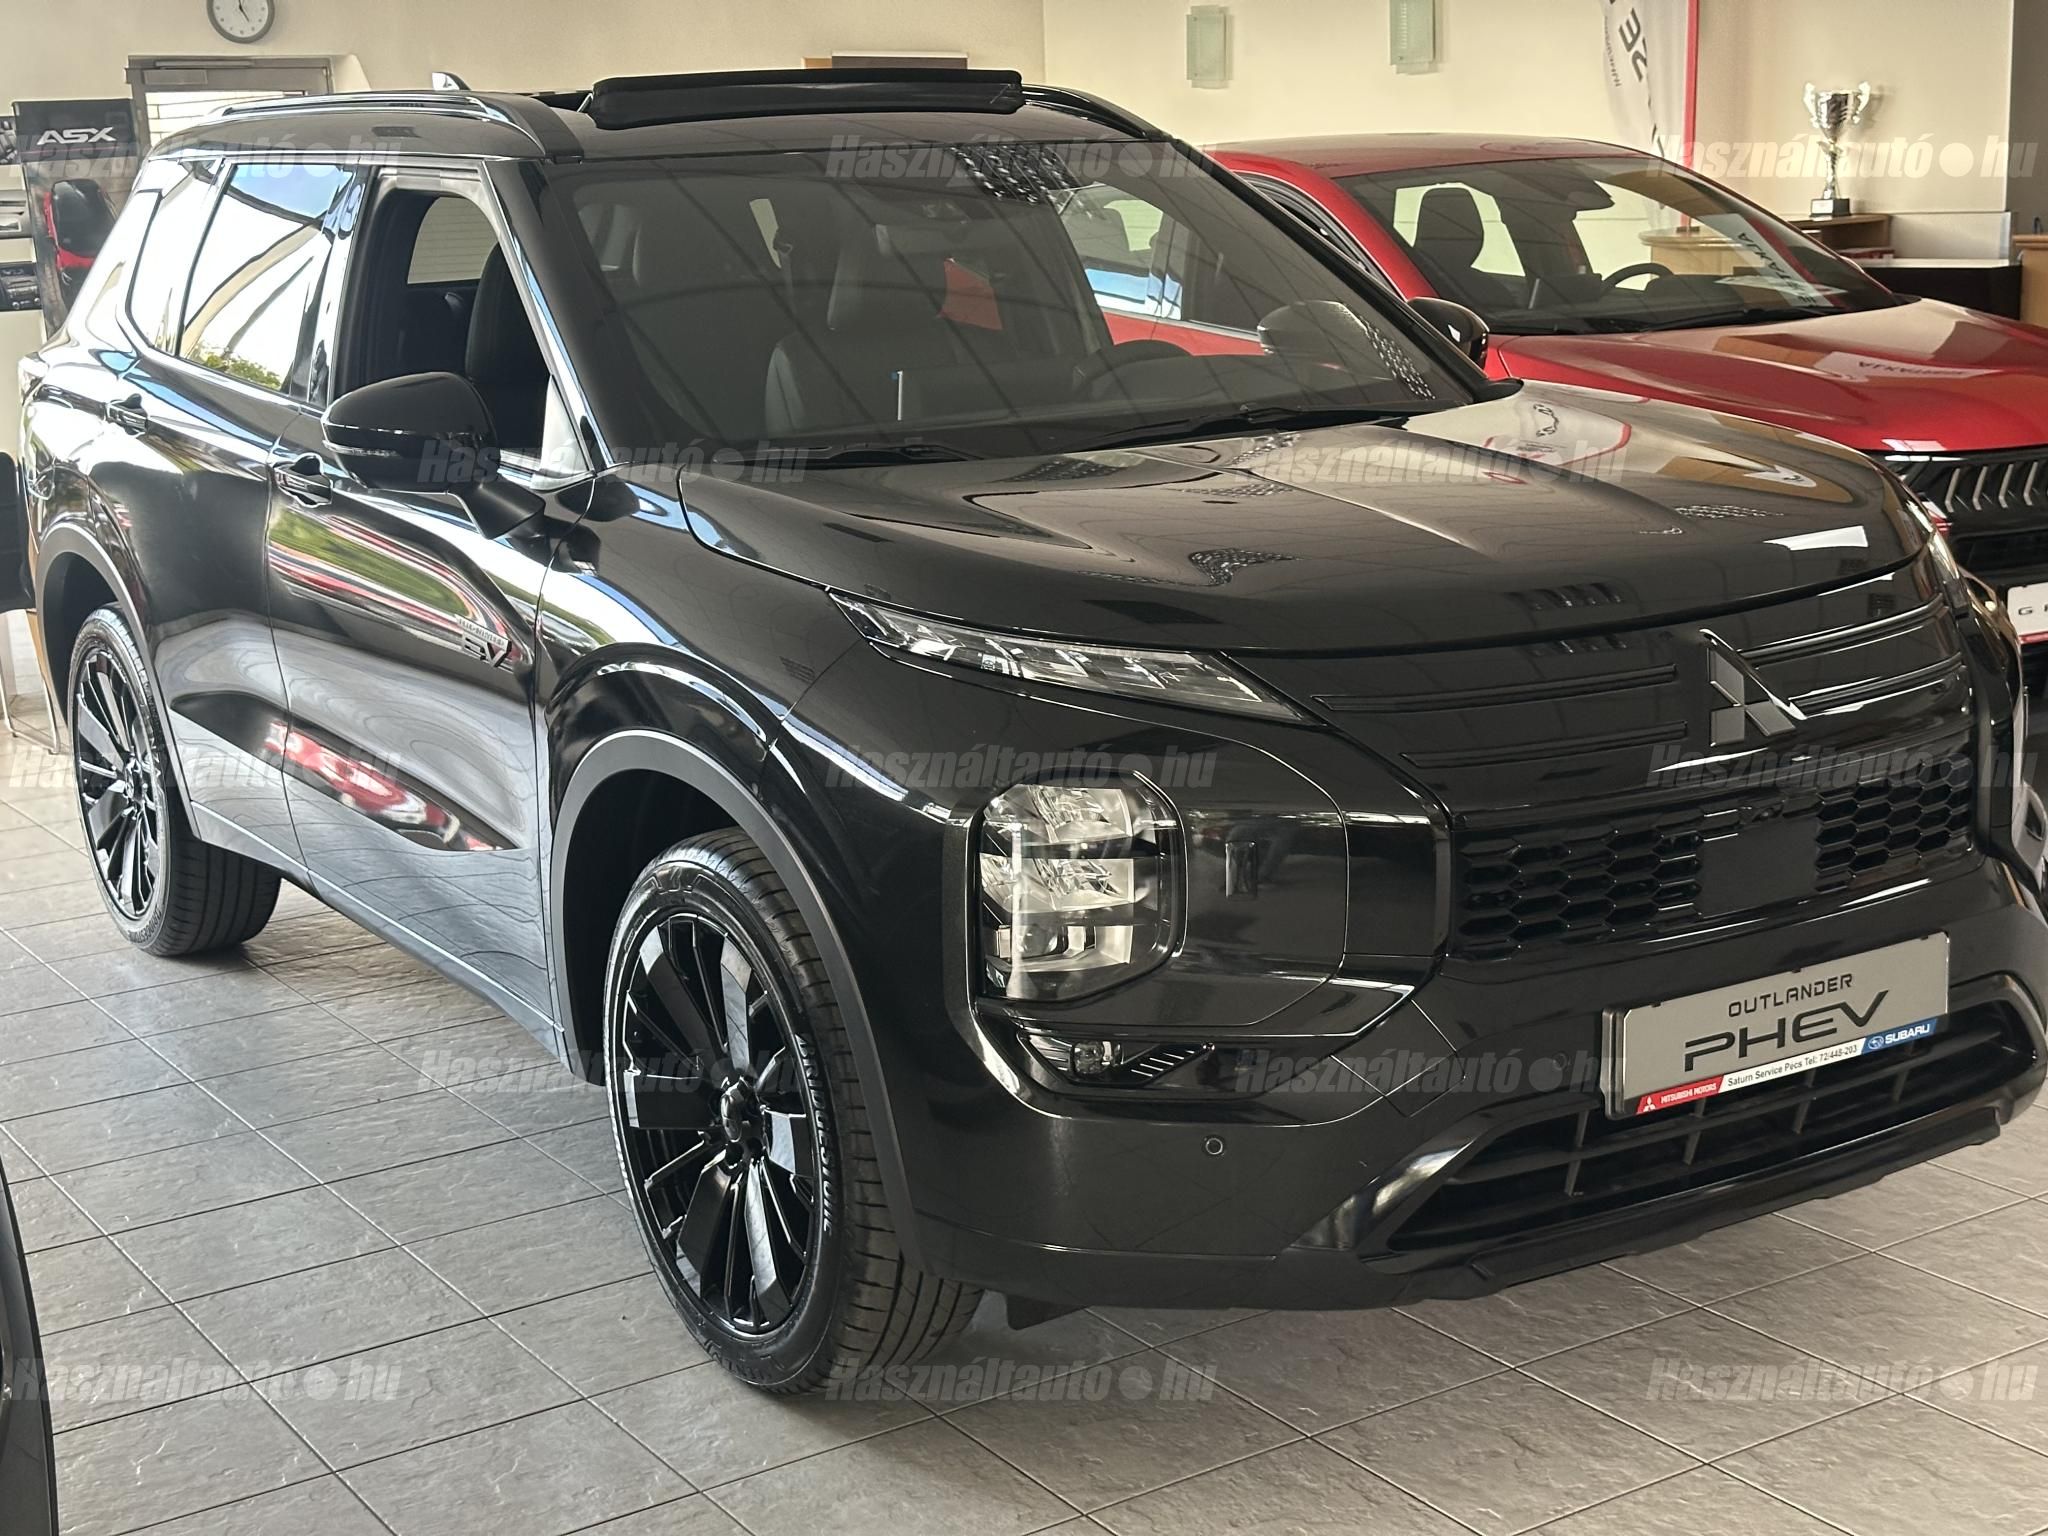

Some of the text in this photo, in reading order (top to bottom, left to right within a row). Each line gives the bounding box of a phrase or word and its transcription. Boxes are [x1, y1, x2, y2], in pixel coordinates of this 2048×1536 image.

[36, 127, 117, 146] ASX
[1728, 973, 1853, 1018] OUTLANDER
[1684, 990, 1889, 1072] PHEV
[1885, 1023, 1930, 1044] SUBARU
[1727, 1076, 1753, 1087] Saturn
[1755, 1066, 1783, 1080] Service
[1660, 1083, 1717, 1104] MITSUBISHI MOTORS
